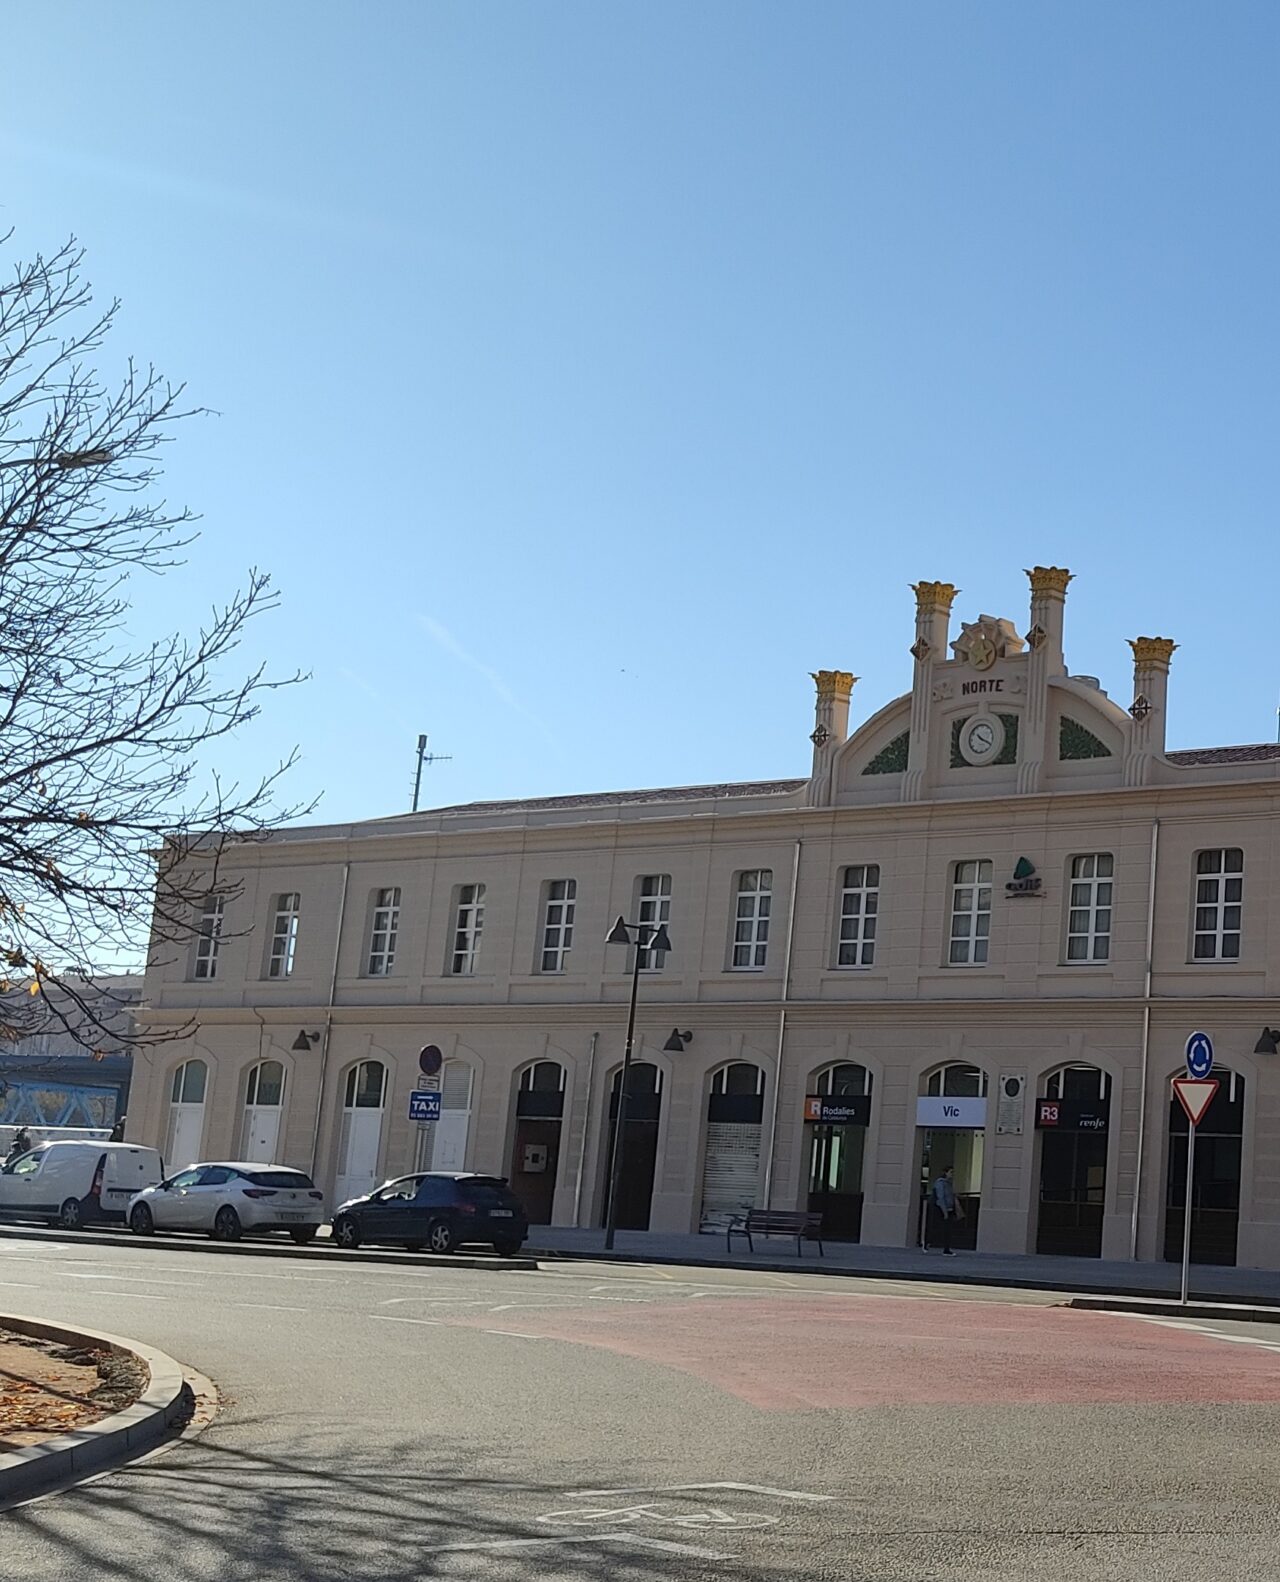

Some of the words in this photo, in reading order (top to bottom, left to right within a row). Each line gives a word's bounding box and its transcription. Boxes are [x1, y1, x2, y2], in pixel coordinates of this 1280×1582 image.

[962, 679, 1005, 696] NORTE
[411, 1101, 439, 1111] TAXI
[811, 1101, 821, 1115] R
[822, 1106, 855, 1115] Rodalies
[943, 1105, 960, 1117] Vic
[1041, 1106, 1058, 1120] R3
[1080, 1118, 1105, 1130] renfe
